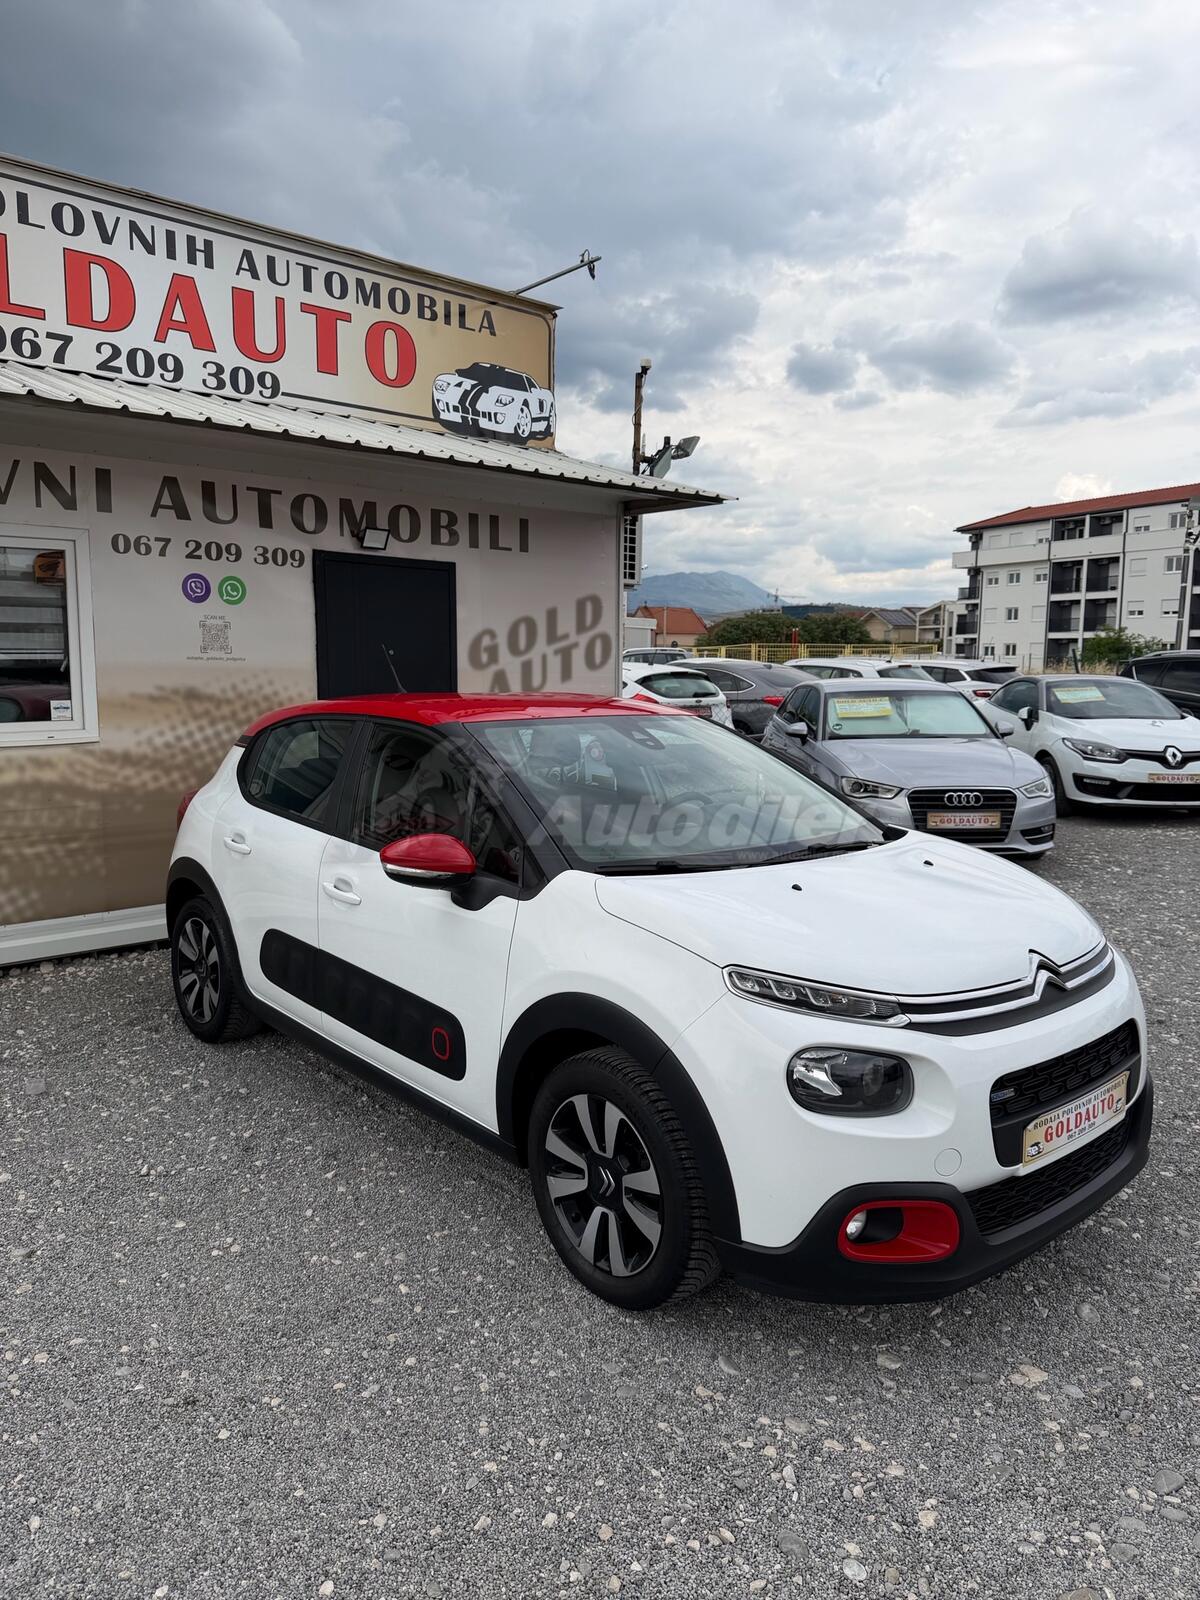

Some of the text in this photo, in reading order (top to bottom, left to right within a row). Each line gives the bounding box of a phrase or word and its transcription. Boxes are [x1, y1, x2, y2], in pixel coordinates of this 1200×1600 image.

[0, 189, 497, 337] LOVNIH AUTOMOBILA
[0, 325, 282, 399] 67 209 309
[150, 475, 529, 553] AUTOMOBILI
[111, 533, 306, 568] 067 209 309
[468, 593, 603, 671] GOLD
[489, 631, 612, 693] AUTO
[1030, 1112, 1061, 1131] RODAJA
[1043, 1093, 1115, 1143] GOLDAUTO
